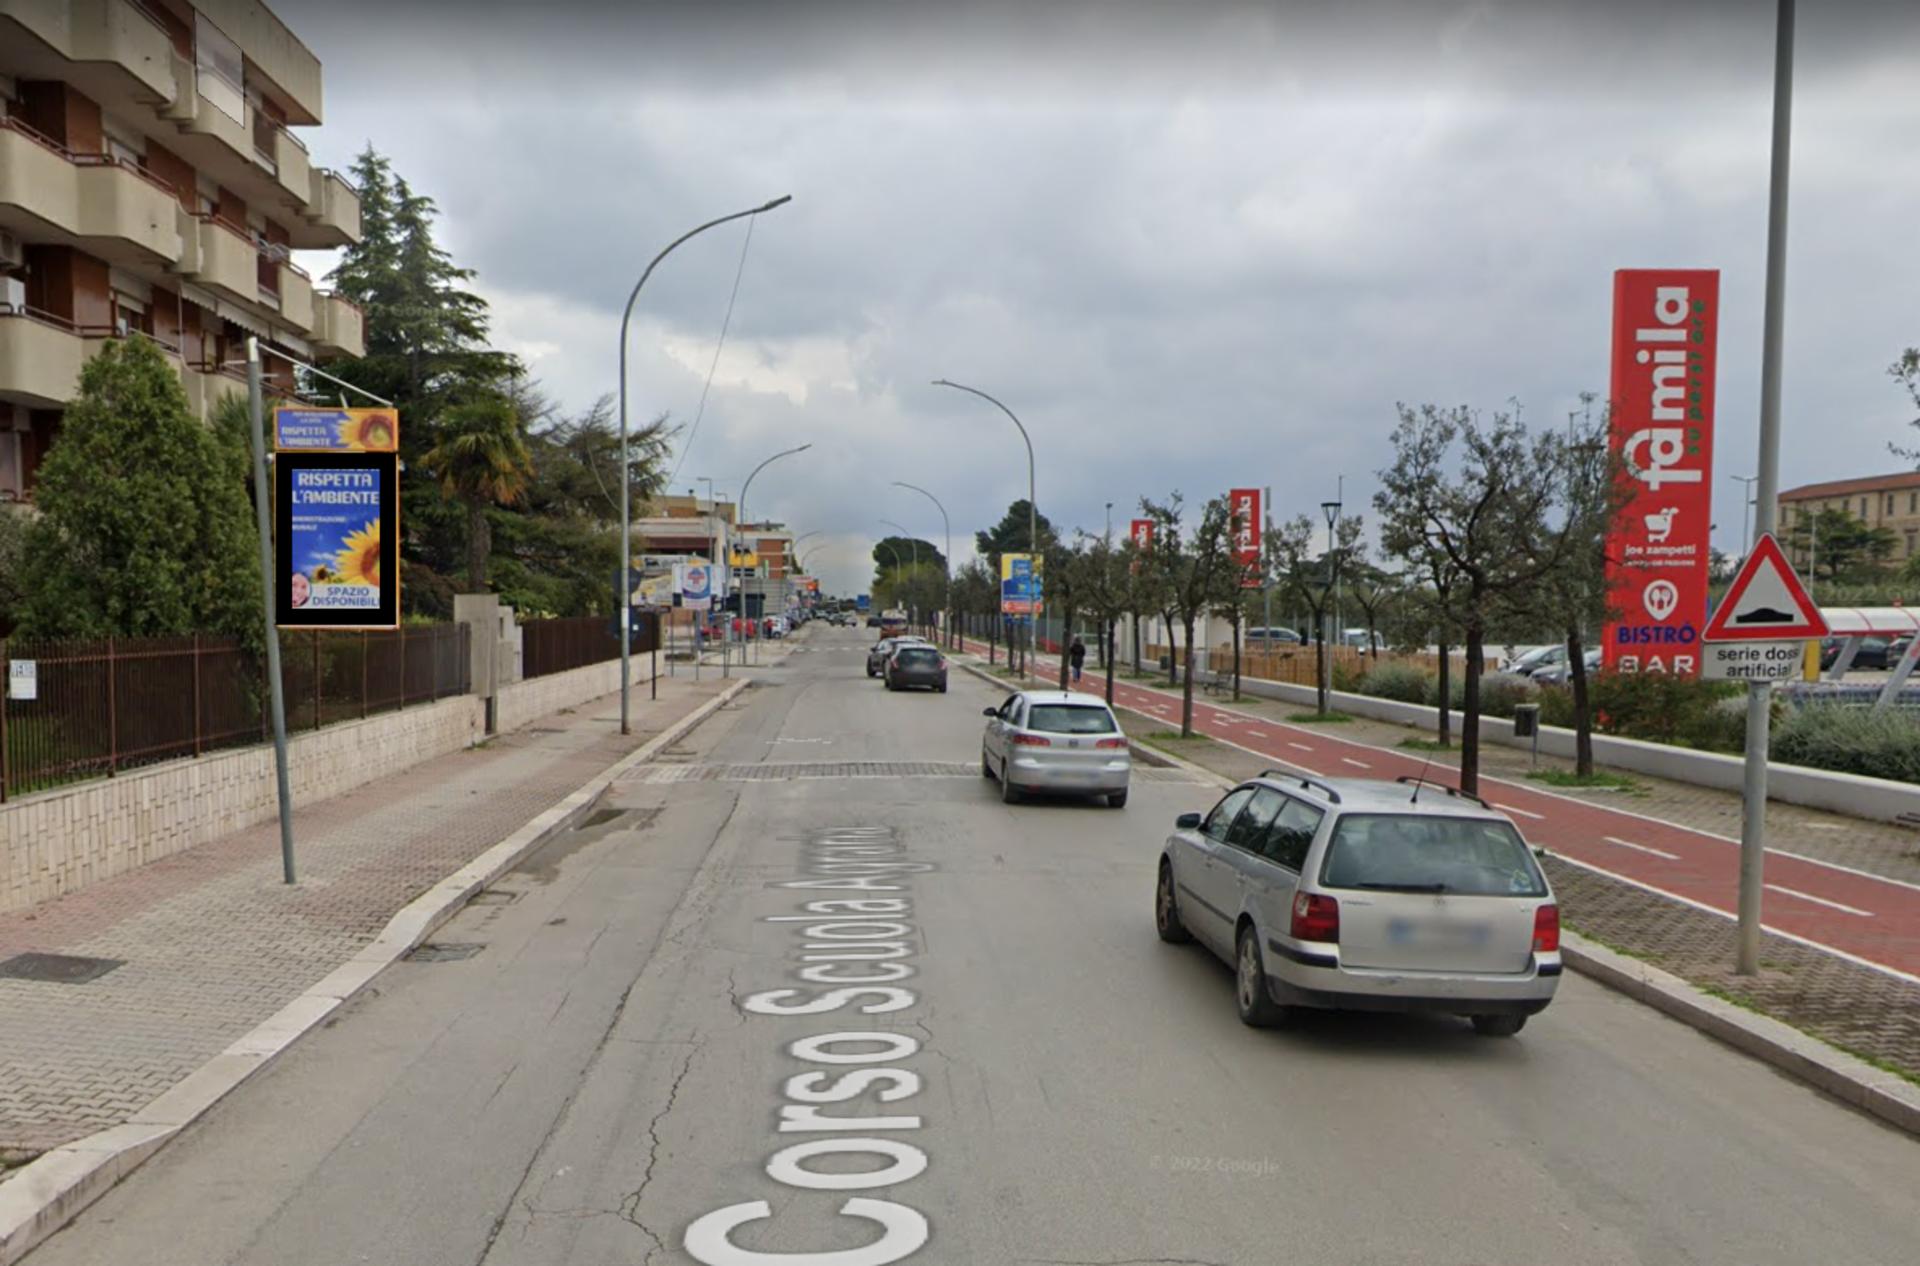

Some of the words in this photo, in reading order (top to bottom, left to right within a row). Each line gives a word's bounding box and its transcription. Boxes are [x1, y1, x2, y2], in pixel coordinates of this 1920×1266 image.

[1622, 286, 1703, 491] famila
[298, 472, 373, 487] RISPETTA
[292, 490, 379, 505] L'AMBIENTE
[1625, 544, 1644, 555] joe
[1646, 544, 1697, 556] zampetti
[327, 586, 370, 596] SPAZIO
[312, 596, 380, 606] DISPONIBIL
[1717, 646, 1760, 661] serie
[1618, 655, 1695, 674] BAR
